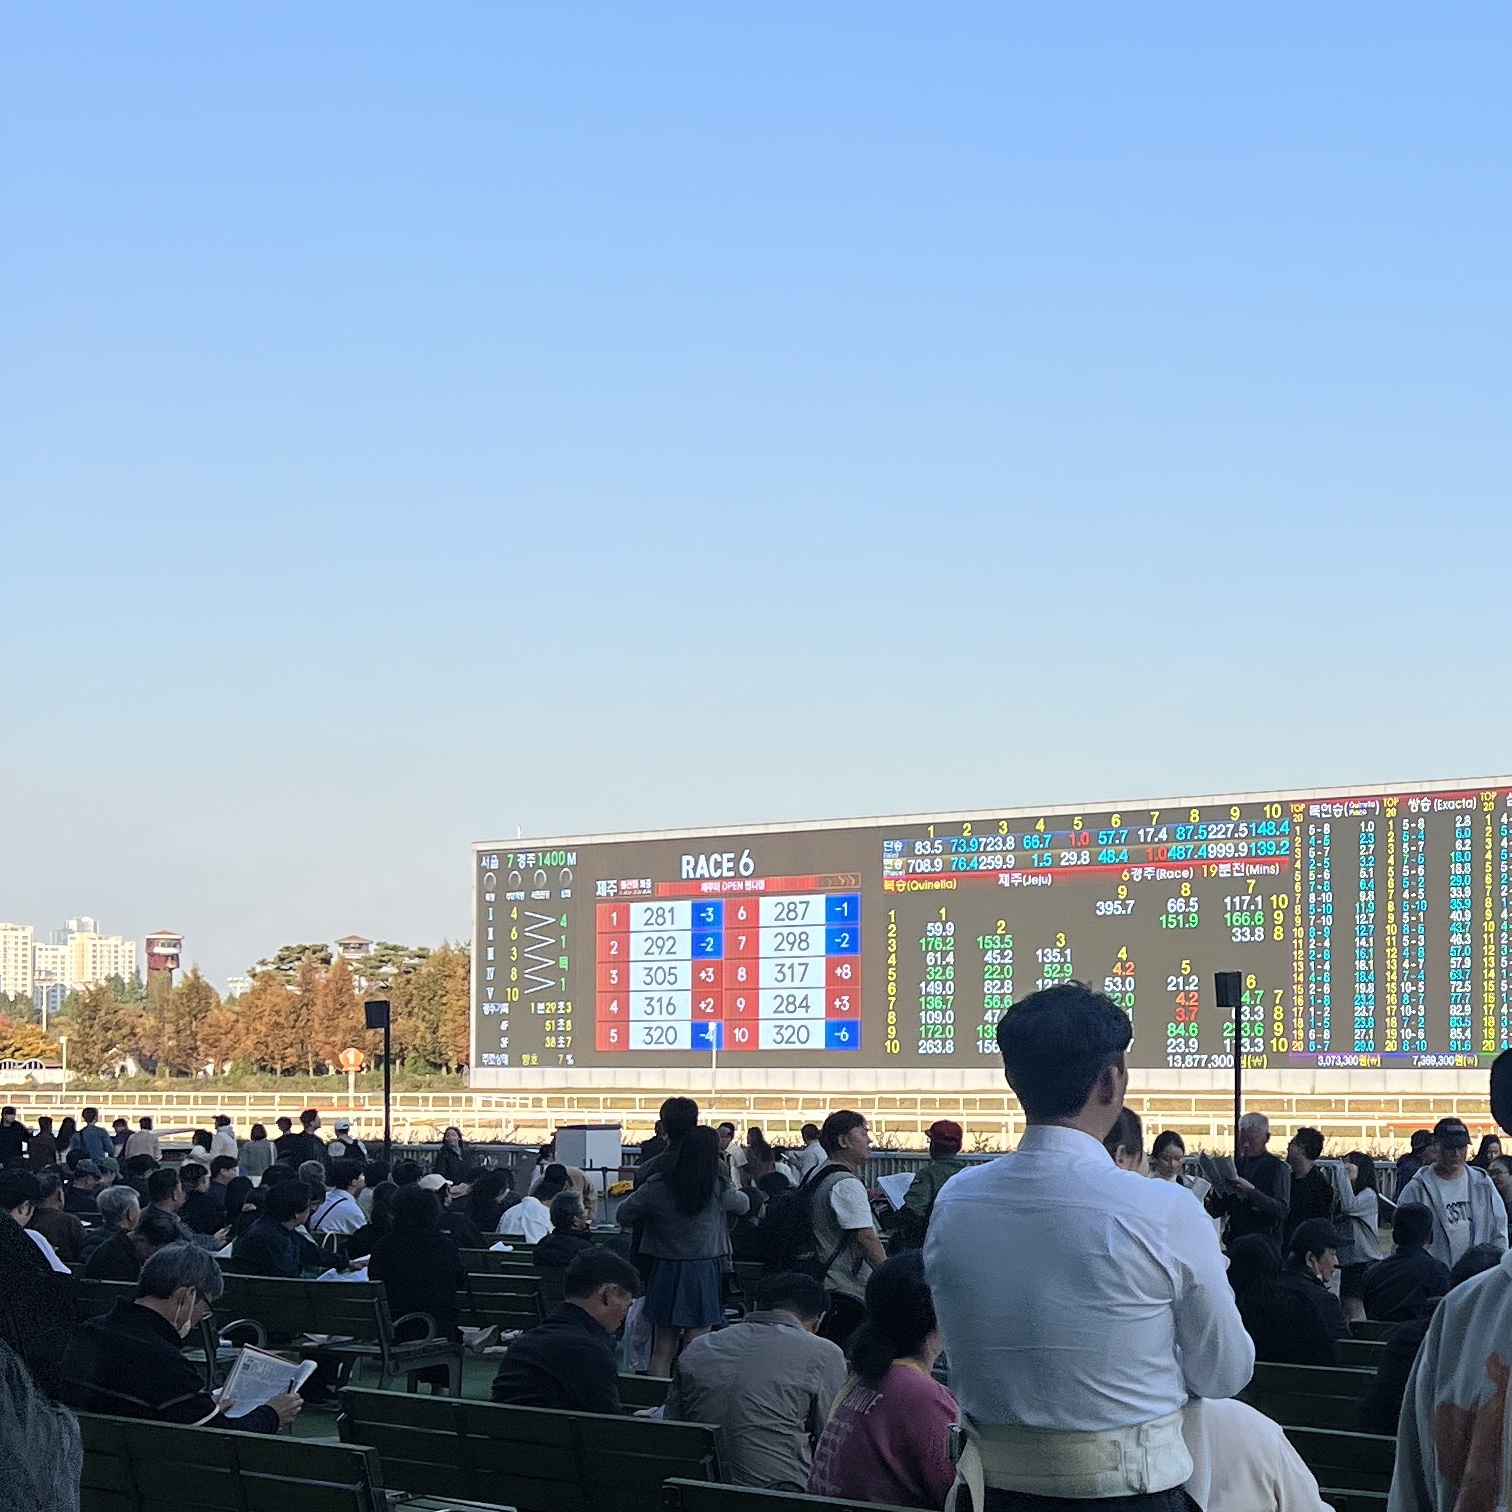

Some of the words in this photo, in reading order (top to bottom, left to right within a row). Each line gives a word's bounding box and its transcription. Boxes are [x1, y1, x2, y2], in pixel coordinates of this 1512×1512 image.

[1068, 831, 1092, 849] 1.0
[1097, 829, 1129, 846] 57.7
[1138, 827, 1167, 842] 17.4
[1174, 824, 1210, 842] 87.5
[1206, 821, 1249, 840] 227.5
[1248, 820, 1291, 836] 148.4
[915, 840, 943, 854] 83.5
[949, 836, 980, 855] 73.9
[977, 836, 1016, 853] 723.8
[1022, 834, 1053, 850] 66.7
[536, 849, 565, 867] 1400
[567, 852, 576, 866] M
[682, 852, 734, 878] RACE
[739, 848, 755, 878] 6
[596, 880, 617, 897] 제주
[1096, 900, 1134, 915] 395.7
[1223, 895, 1263, 911] 117.1
[611, 912, 616, 926] 1
[644, 907, 674, 926] 281
[738, 906, 746, 920] 6
[774, 901, 810, 921] 287
[610, 941, 618, 954] 2
[644, 936, 676, 955] 292
[738, 936, 746, 950] 7
[774, 931, 809, 951] 298
[610, 970, 619, 984] 3
[643, 966, 677, 985] 305
[738, 967, 746, 981] 8
[775, 963, 809, 982] 317
[610, 1000, 618, 1013] 4
[644, 996, 676, 1015] 316
[737, 998, 745, 1012] 9
[773, 994, 810, 1013] 284
[610, 1029, 617, 1042] 5
[643, 1026, 677, 1045] 320
[733, 1028, 748, 1042] 10
[773, 1025, 810, 1044] 320
[920, 1023, 955, 1040] 172.0
[1167, 1020, 1199, 1039] 84.6
[919, 1040, 955, 1053] 263.8
[1167, 1036, 1199, 1052] 23.9
